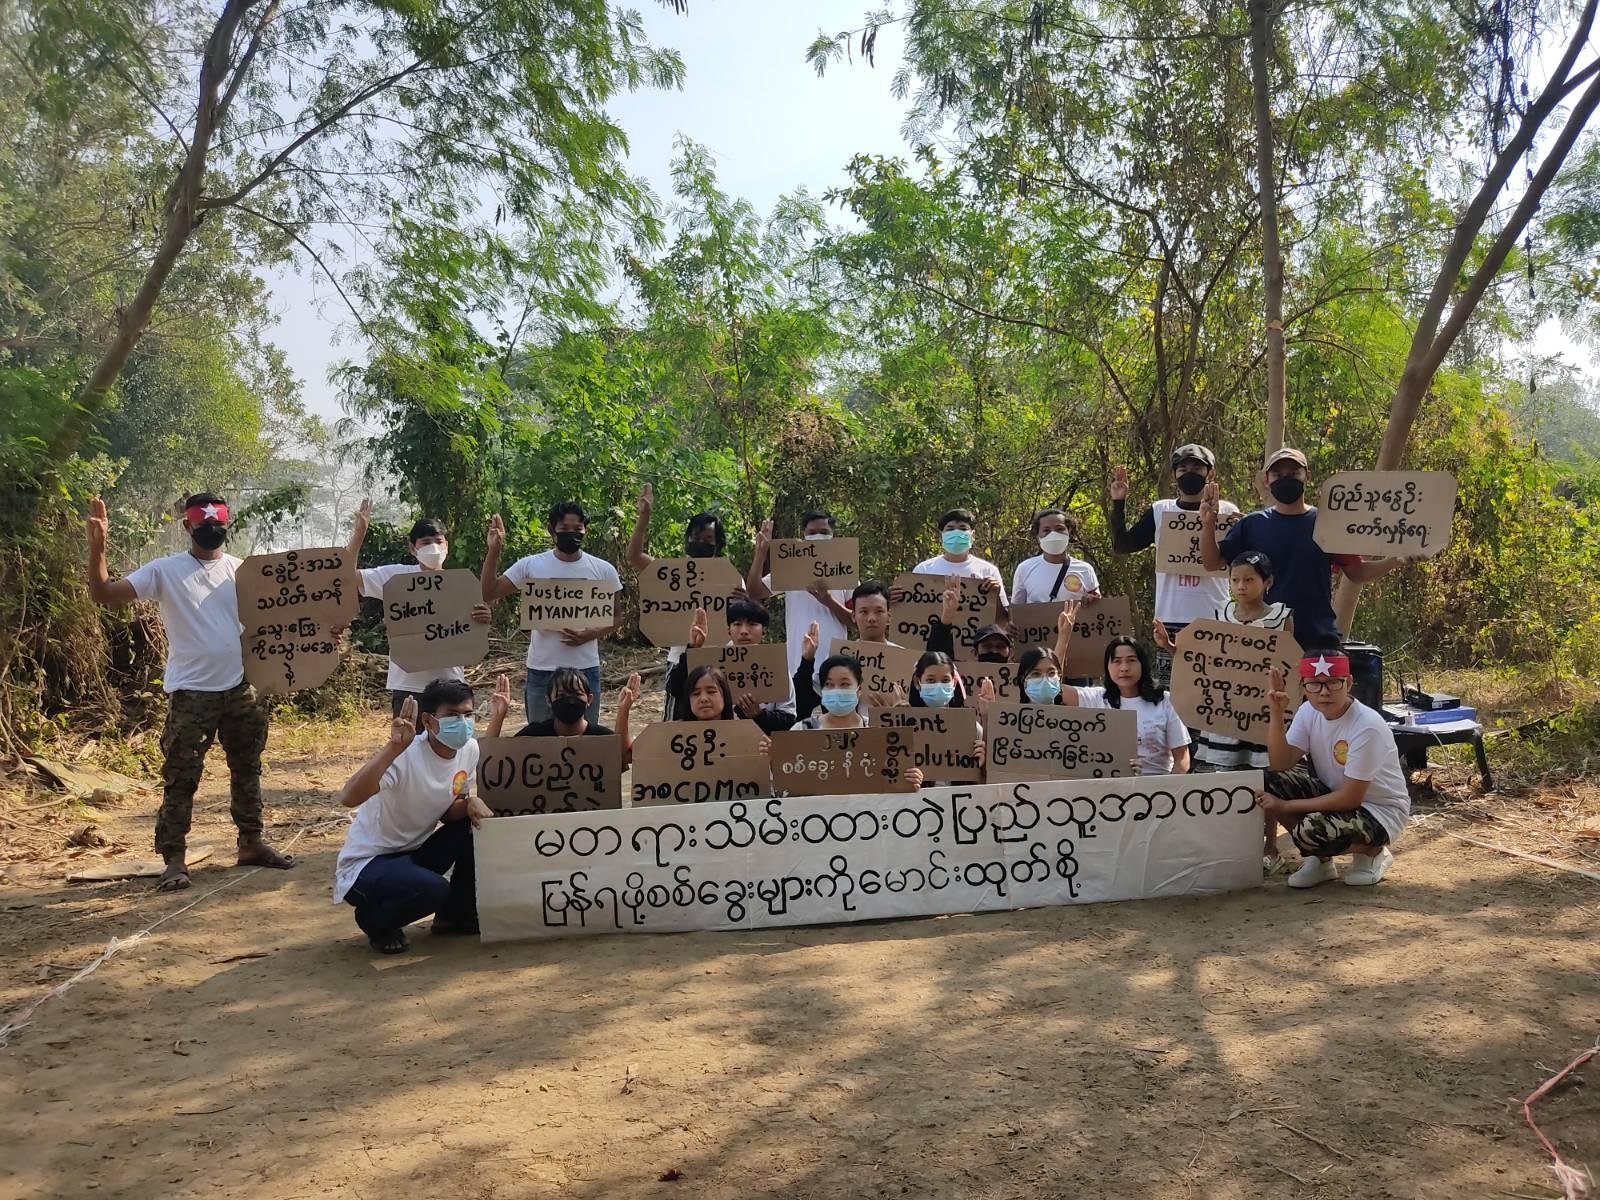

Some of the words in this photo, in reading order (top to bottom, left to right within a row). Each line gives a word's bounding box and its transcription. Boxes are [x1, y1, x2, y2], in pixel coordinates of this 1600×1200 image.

[777, 543, 817, 559] Silent
[812, 561, 854, 578] Strike
[525, 582, 584, 600] Justice
[389, 599, 435, 621] Silent
[528, 604, 613, 621] MYANMAR
[424, 621, 471, 641] Strike
